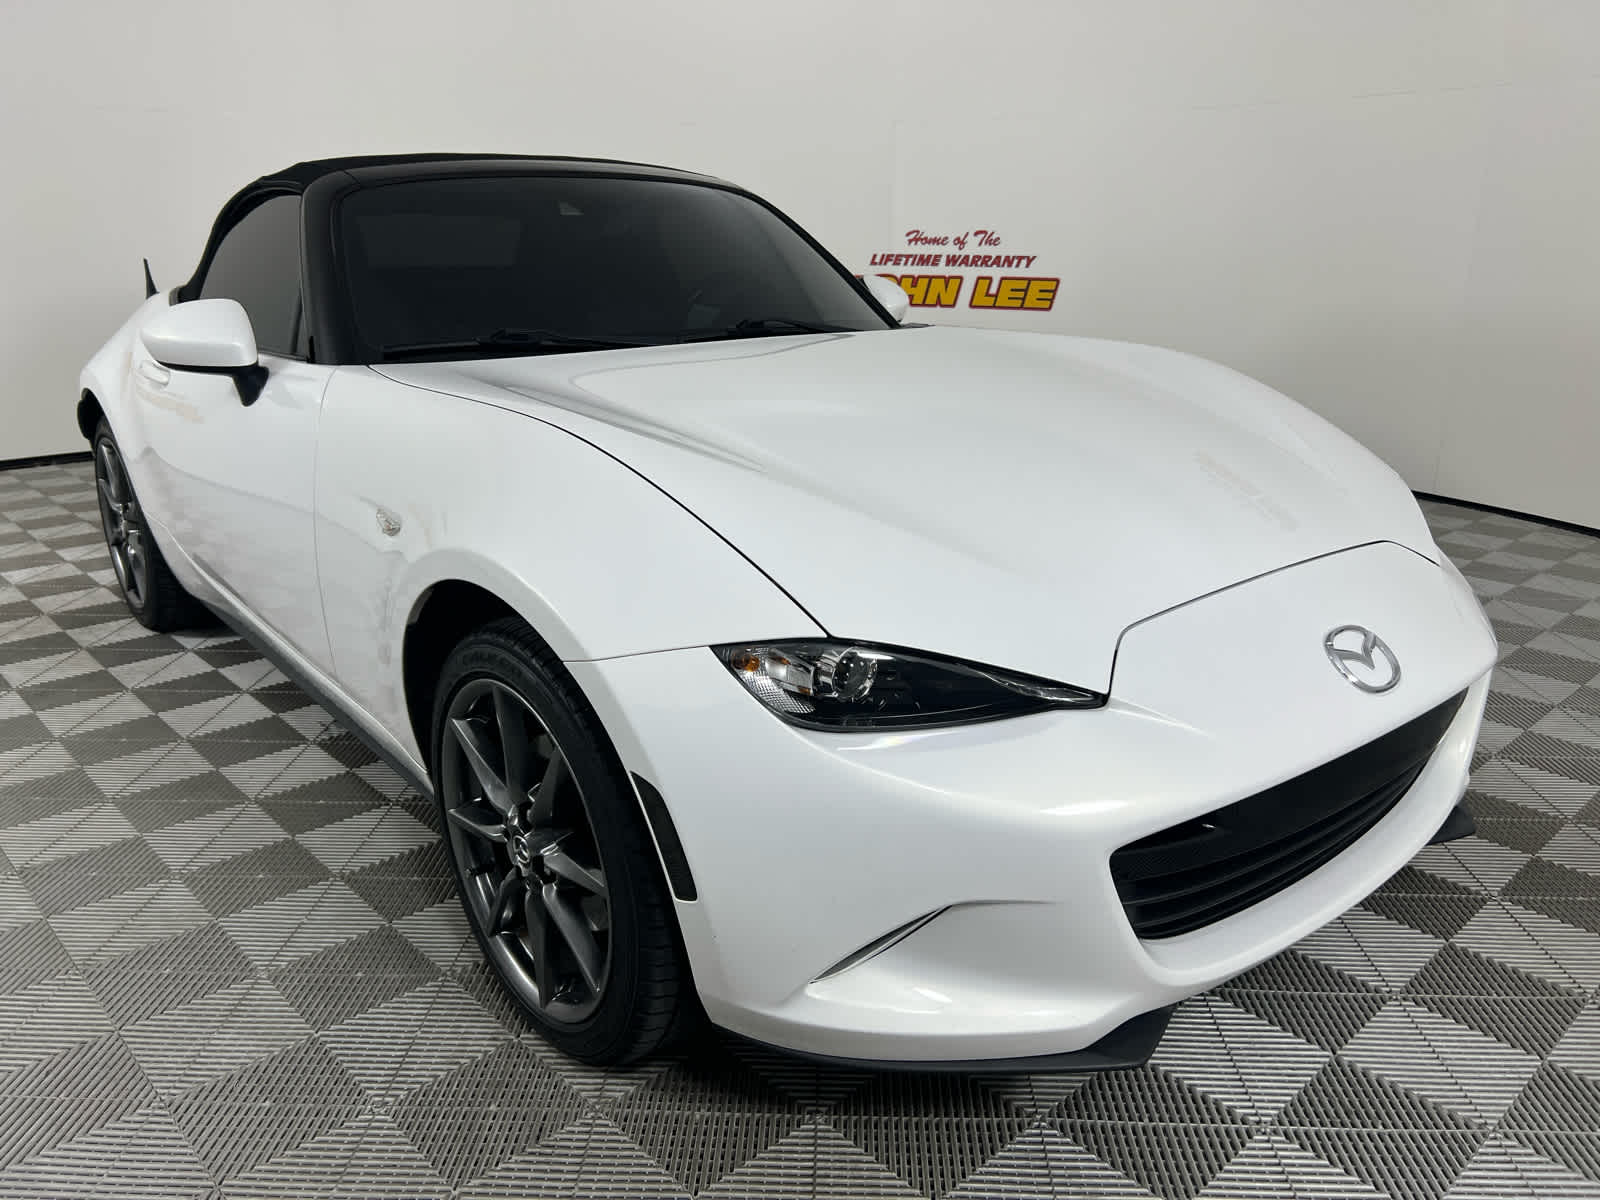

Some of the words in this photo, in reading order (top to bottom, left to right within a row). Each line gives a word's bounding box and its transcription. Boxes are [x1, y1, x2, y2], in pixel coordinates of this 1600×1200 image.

[905, 230, 949, 246] Home
[952, 231, 970, 250] of
[973, 230, 1001, 247] The
[870, 253, 942, 267] LIFETIME
[945, 254, 1037, 268] WARRANTY
[969, 276, 1061, 312] LEE
